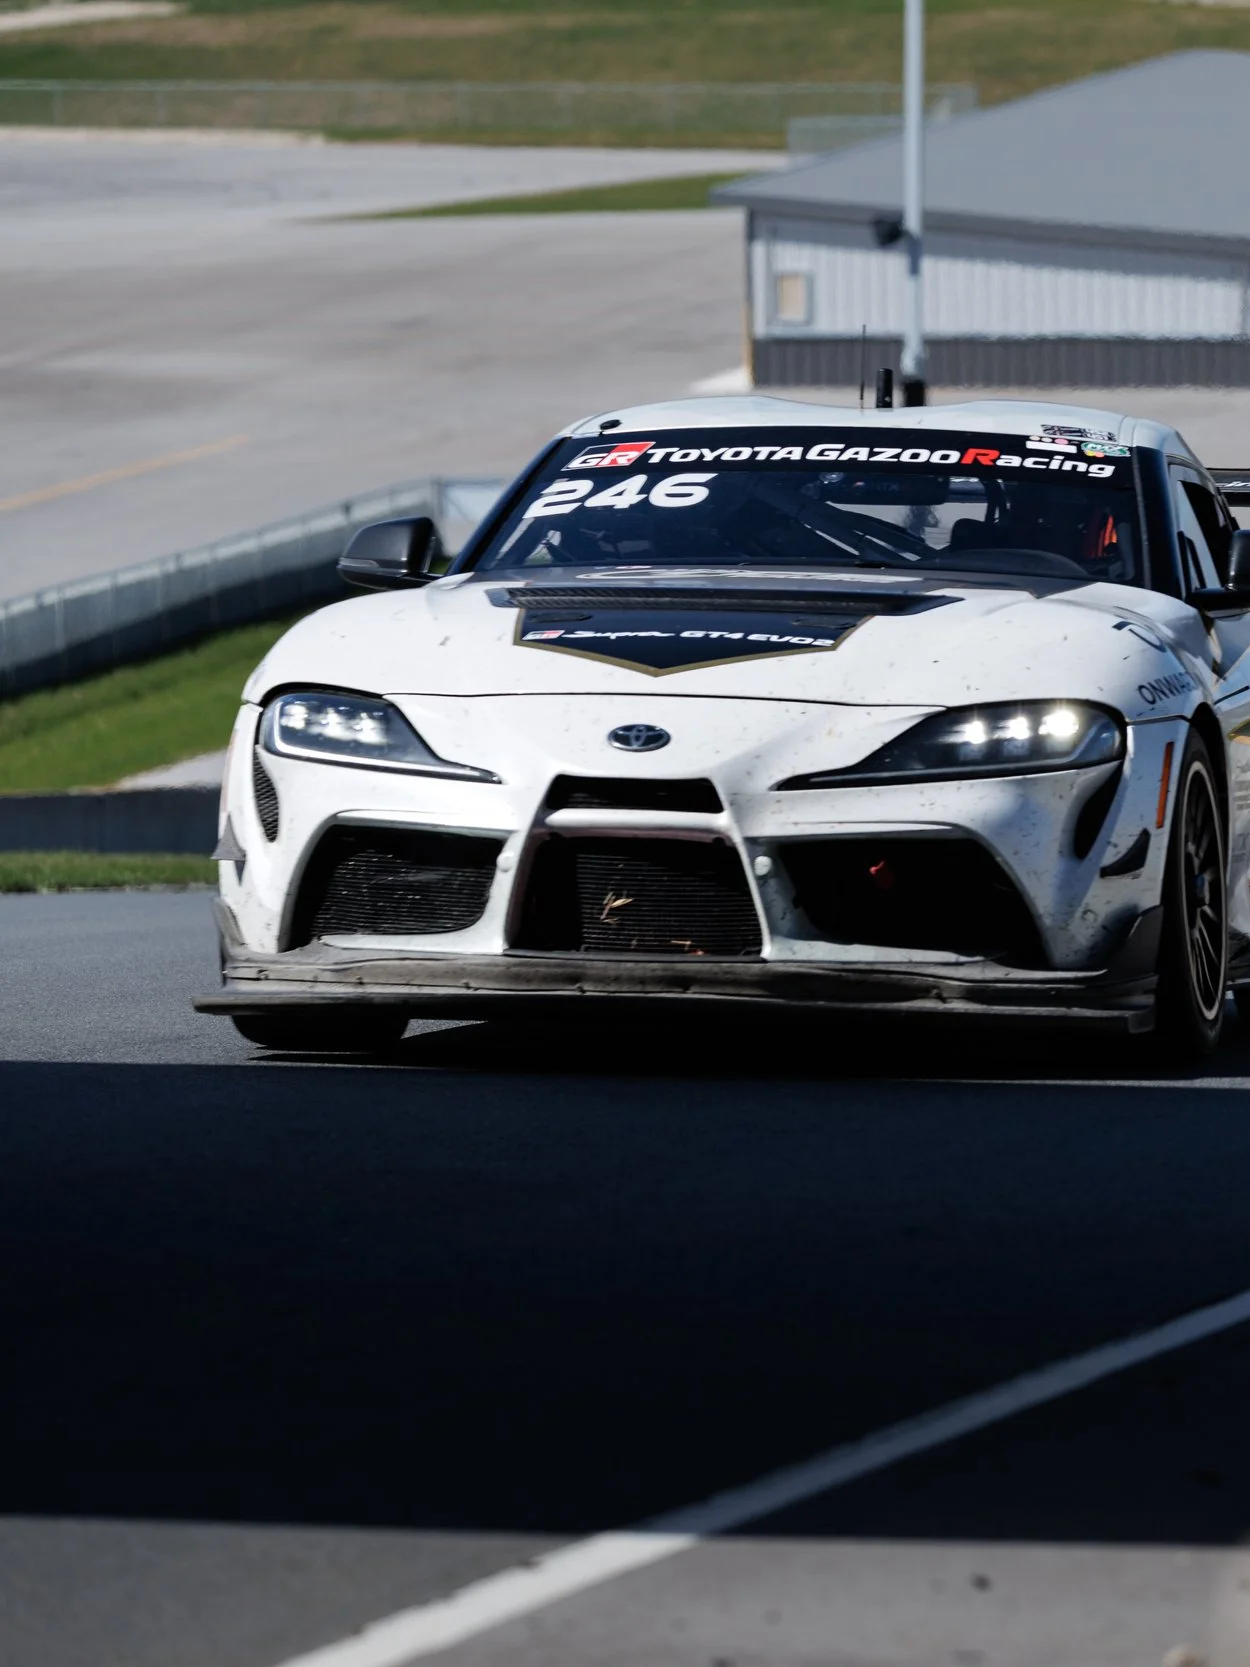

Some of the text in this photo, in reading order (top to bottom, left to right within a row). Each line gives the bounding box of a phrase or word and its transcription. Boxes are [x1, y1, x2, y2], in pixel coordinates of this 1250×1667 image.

[522, 472, 719, 520] 246
[679, 629, 745, 641] GT4
[746, 632, 837, 647] EVO2
